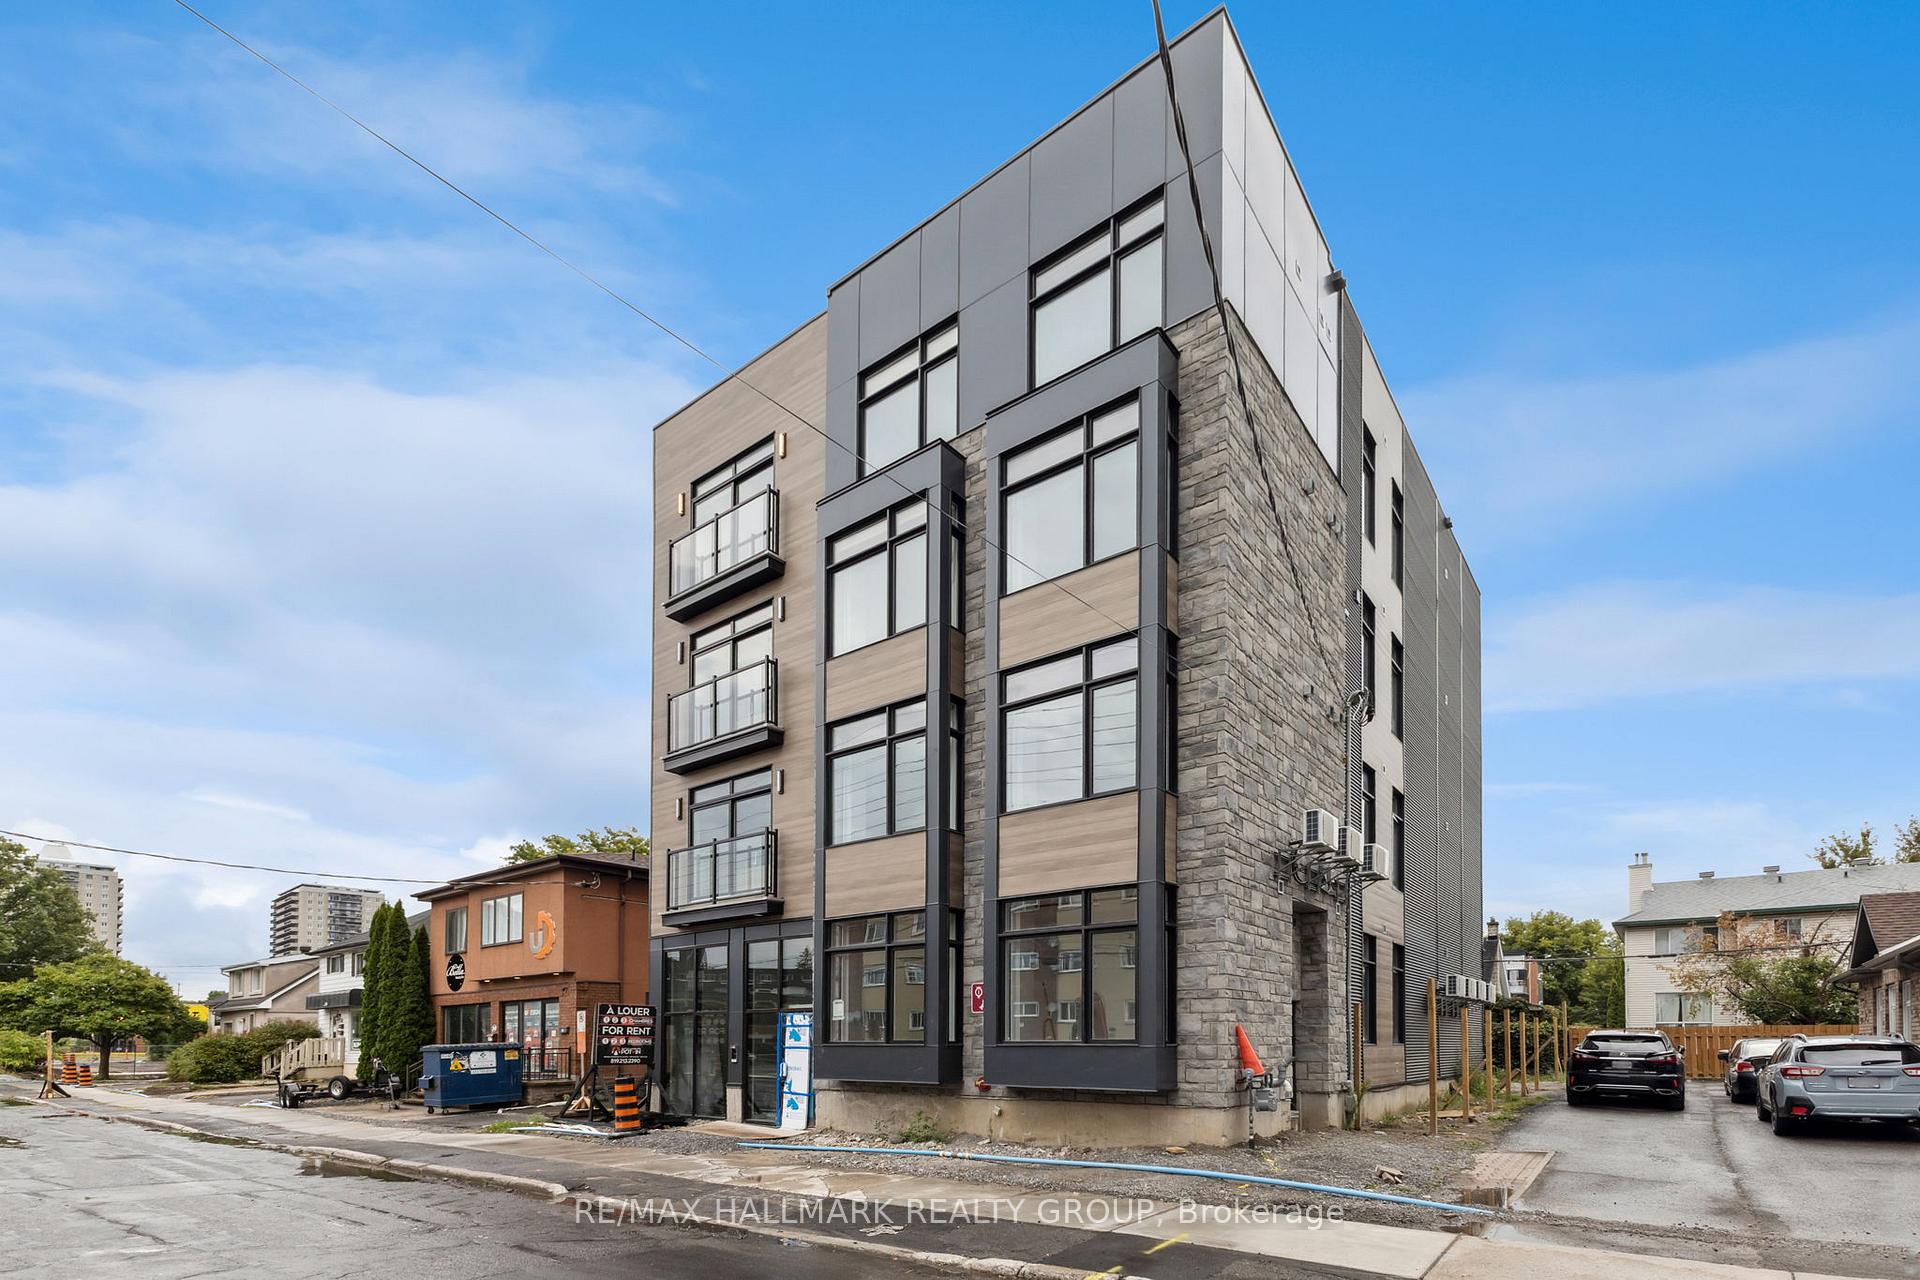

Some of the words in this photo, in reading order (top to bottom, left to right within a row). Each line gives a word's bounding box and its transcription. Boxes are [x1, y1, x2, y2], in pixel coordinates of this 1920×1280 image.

[606, 1004, 615, 1015] À
[617, 1006, 650, 1016] LOUER
[602, 1026, 624, 1035] FOR
[626, 1026, 652, 1036] RENT
